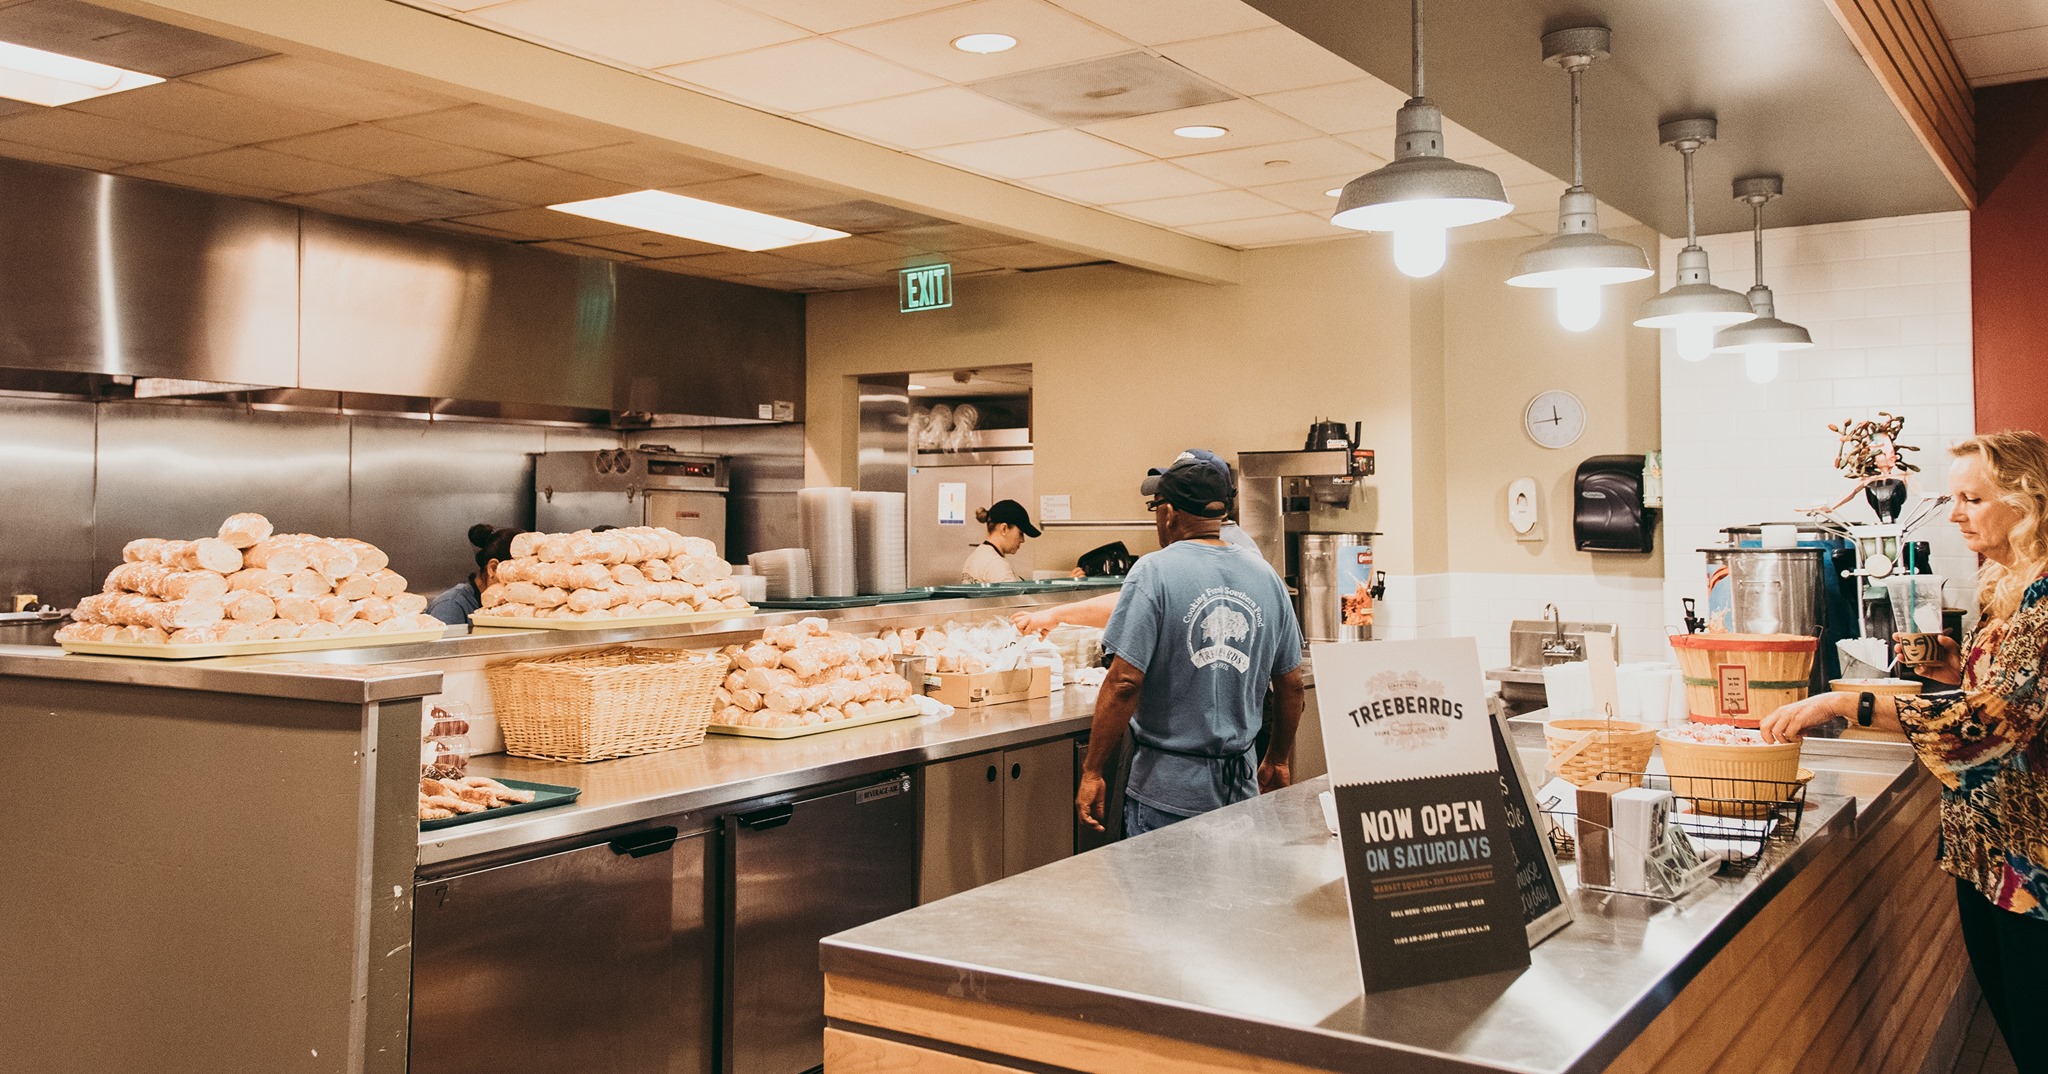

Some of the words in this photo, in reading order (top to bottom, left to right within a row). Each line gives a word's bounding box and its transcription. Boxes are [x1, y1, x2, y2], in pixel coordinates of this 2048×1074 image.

[907, 269, 945, 308] EXIT
[1183, 592, 1208, 624] Cooking
[1224, 586, 1257, 608] Southern
[1254, 605, 1265, 628] Food
[1348, 696, 1463, 728] TREEBEARDS
[1360, 807, 1414, 844] NOW
[1420, 800, 1486, 836] OPEN
[1365, 848, 1390, 873] ON
[1393, 836, 1491, 869] SATURDAYS
[1390, 910, 1404, 918] FULL
[1404, 907, 1420, 916] MENU
[1422, 903, 1452, 913] COCKTAILS
[1454, 900, 1469, 909] WINE
[1471, 898, 1485, 907] BEER
[1441, 926, 1468, 938] STARTING
